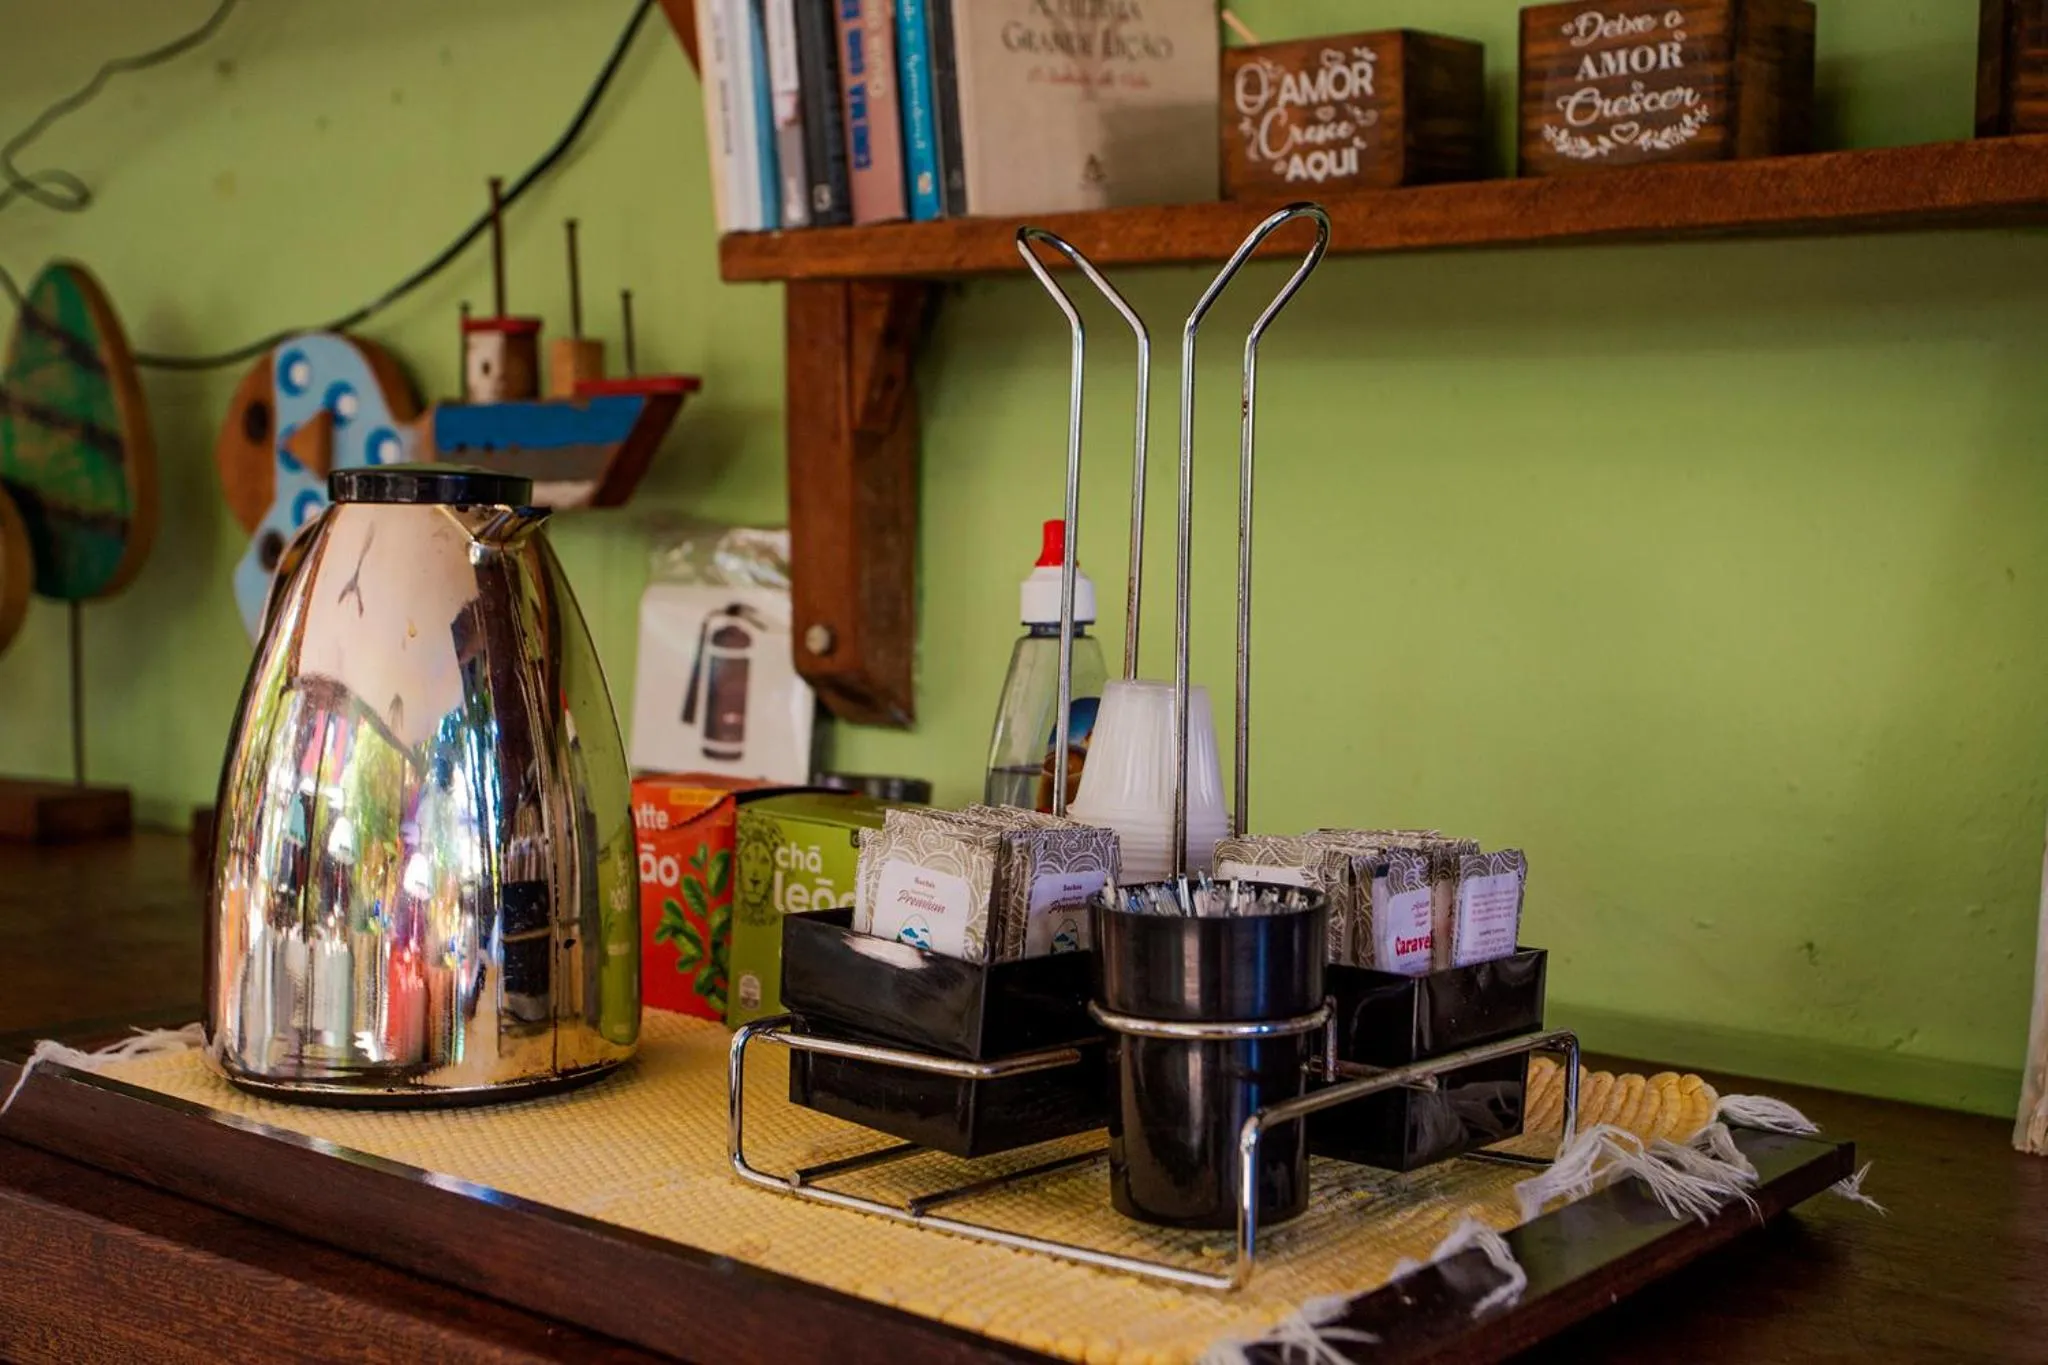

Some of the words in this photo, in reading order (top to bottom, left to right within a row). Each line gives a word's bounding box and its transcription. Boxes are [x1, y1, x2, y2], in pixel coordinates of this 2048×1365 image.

[1278, 60, 1374, 106] AMOR
[1574, 41, 1684, 82] AMOR
[634, 803, 669, 830] tte
[639, 842, 680, 888] ão
